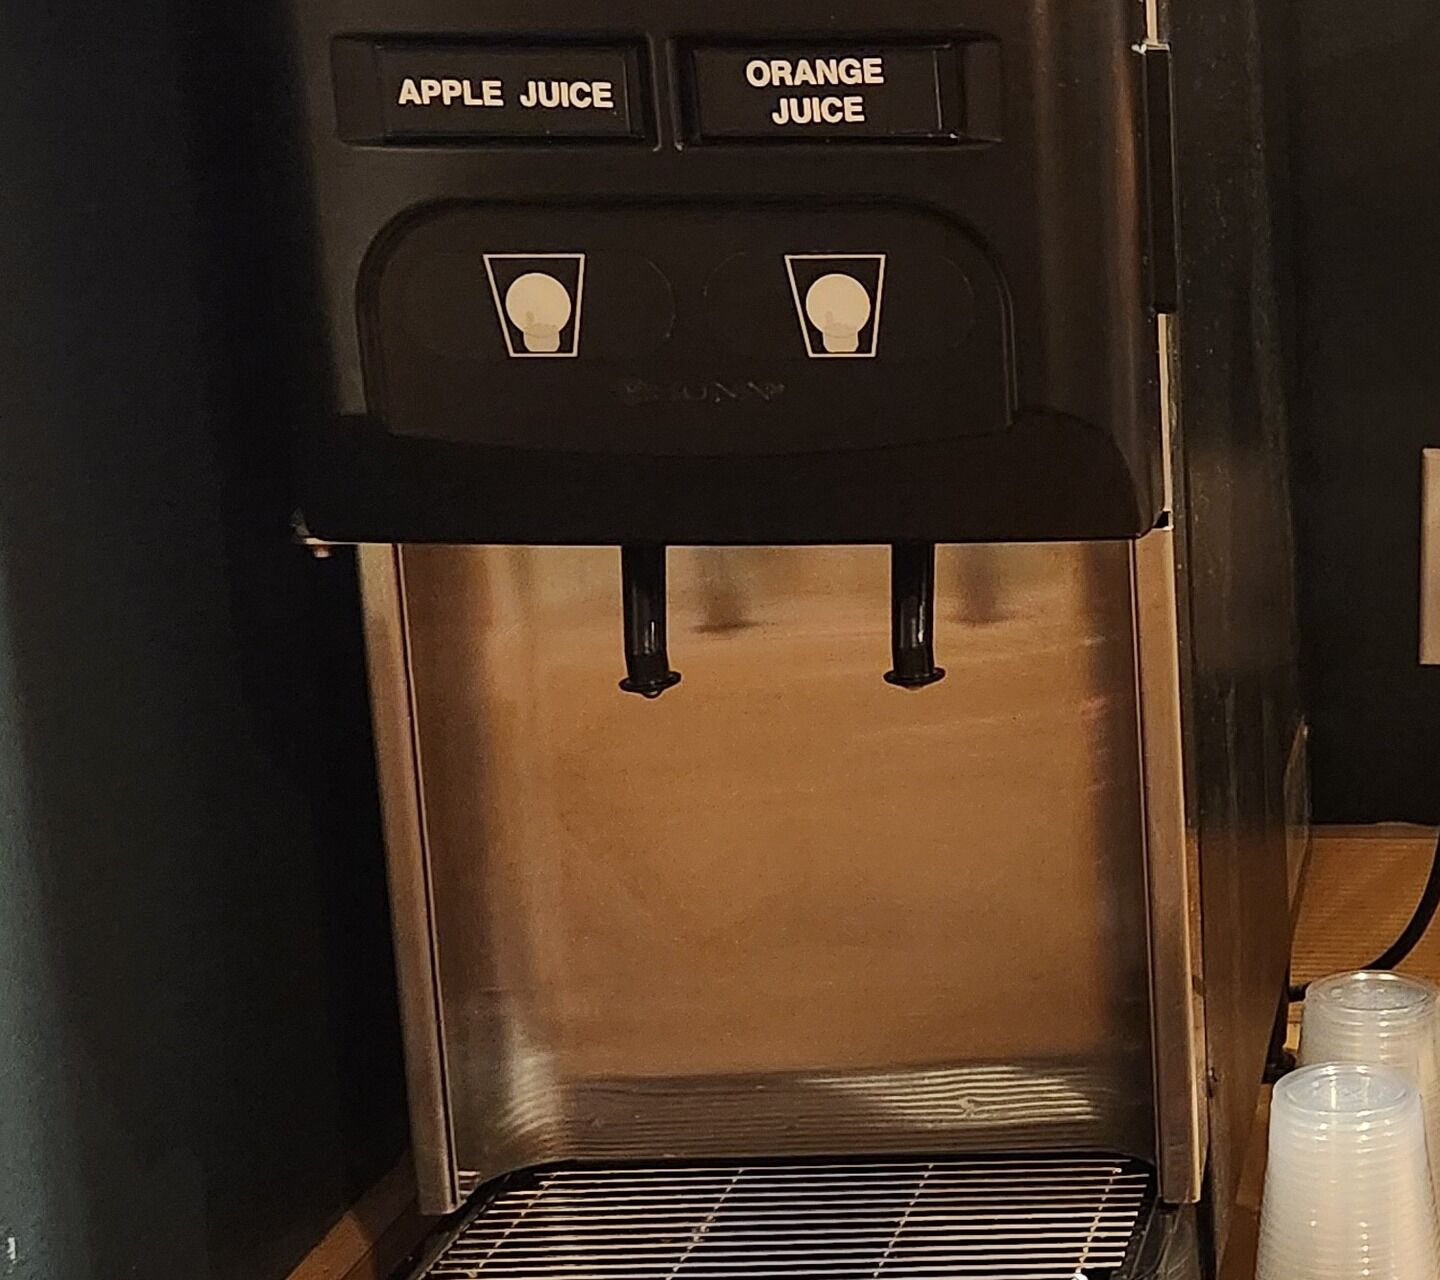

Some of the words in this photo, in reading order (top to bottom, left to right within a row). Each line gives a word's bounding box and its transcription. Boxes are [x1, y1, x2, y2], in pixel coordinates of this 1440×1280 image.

[745, 57, 885, 87] ORANGE
[398, 78, 504, 108] APPLE
[519, 80, 614, 110] JUICE
[771, 95, 865, 124] JUICE
